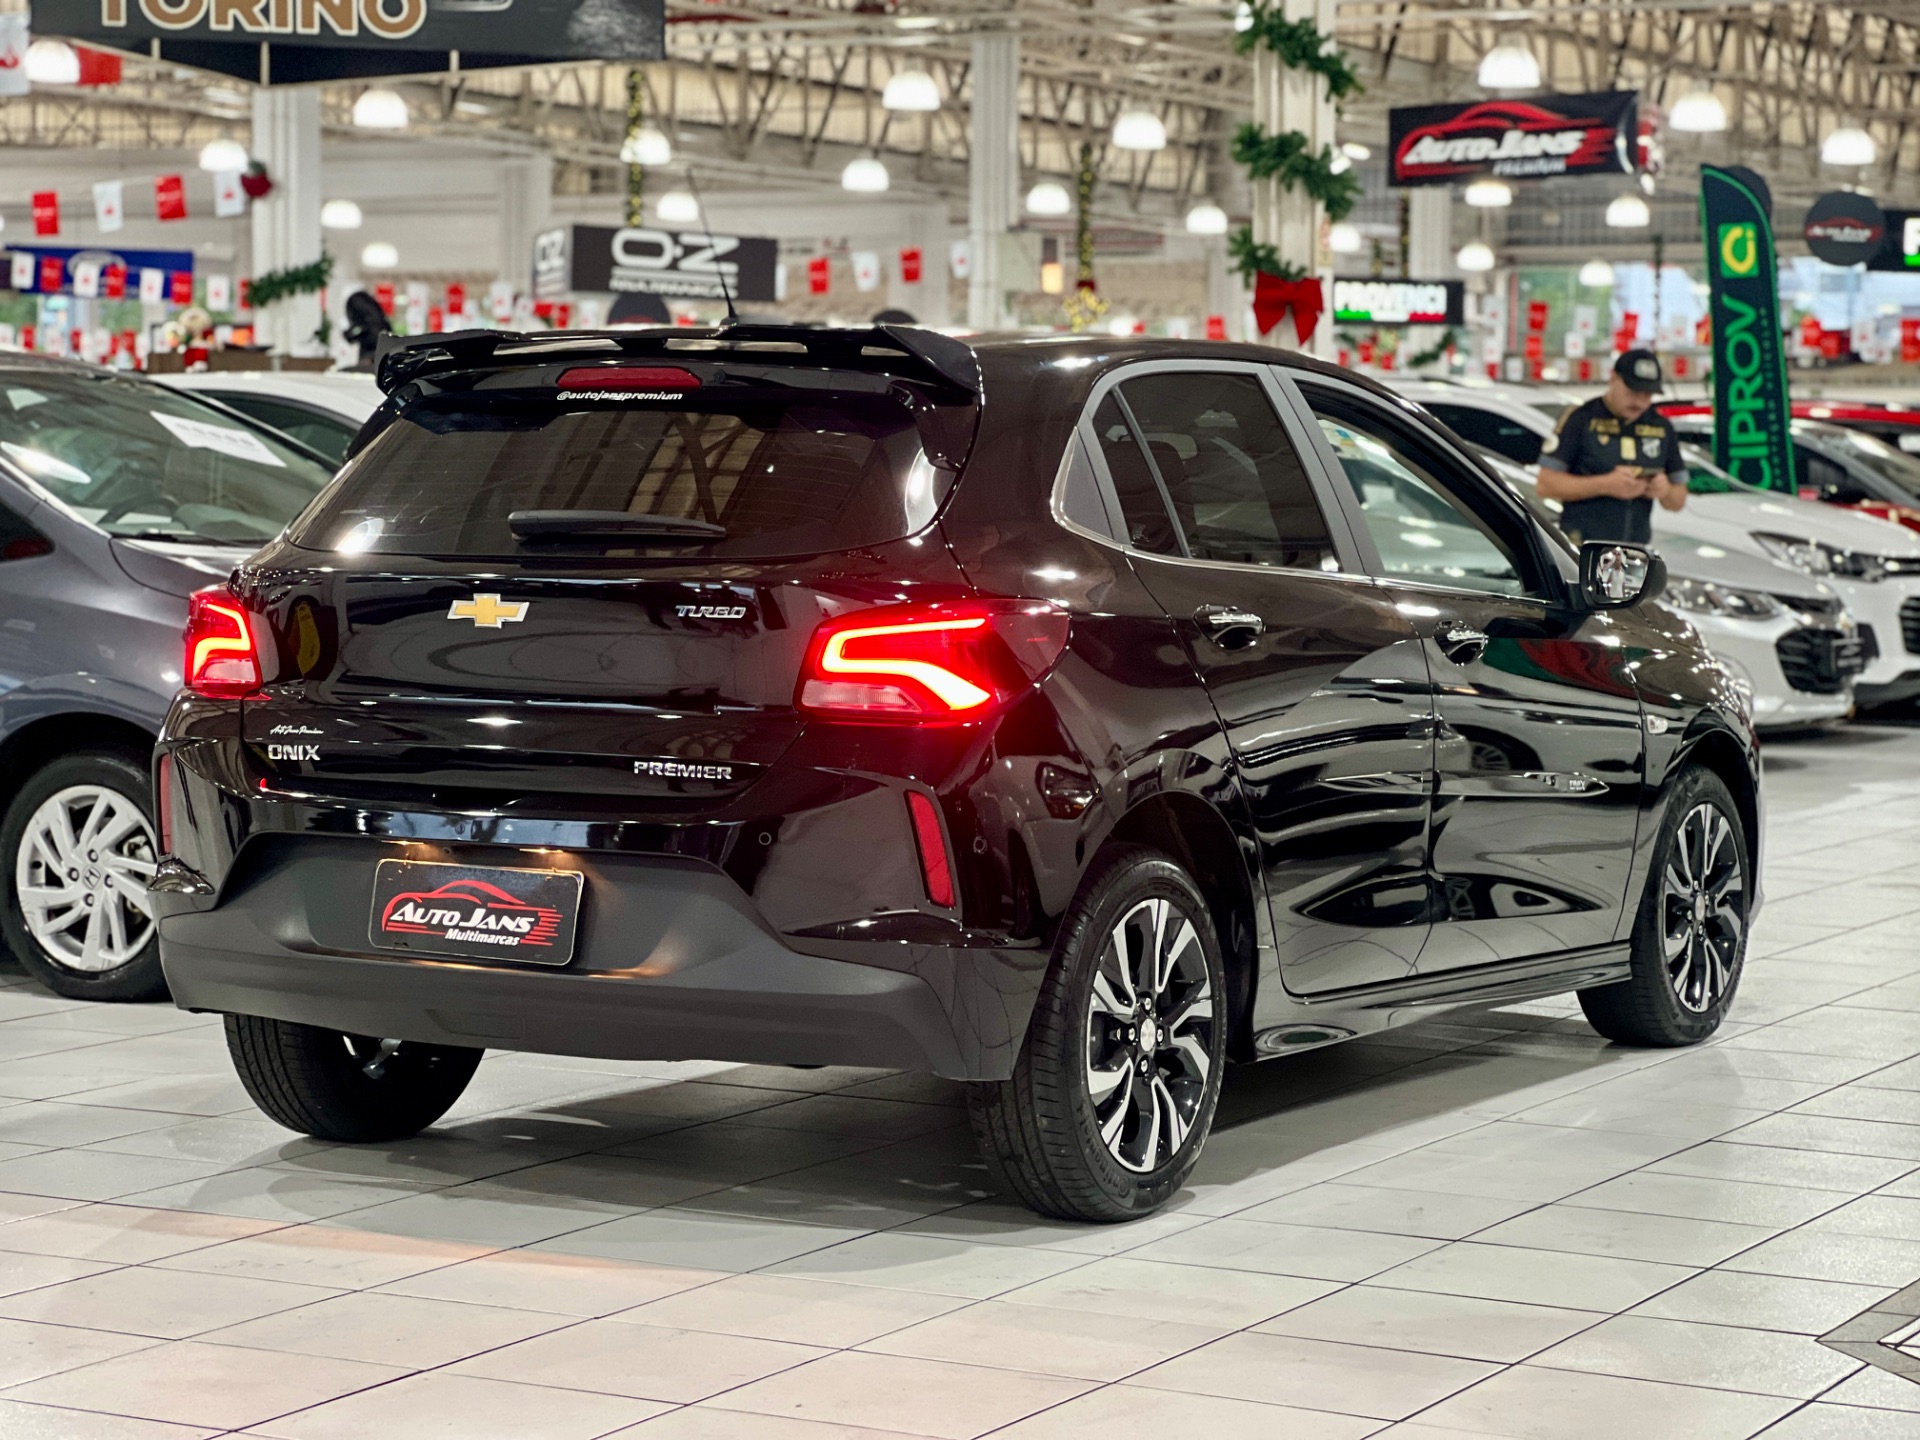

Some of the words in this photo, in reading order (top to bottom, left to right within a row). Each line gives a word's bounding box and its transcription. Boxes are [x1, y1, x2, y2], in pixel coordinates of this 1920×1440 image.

[1721, 293, 1773, 491] CIPROV
[675, 605, 747, 619] TURBO
[267, 744, 321, 760] ONIX
[633, 761, 733, 780] PREMIER
[390, 902, 461, 925] AUTO
[458, 908, 535, 933] JANS
[445, 928, 520, 946] Multimarcas
